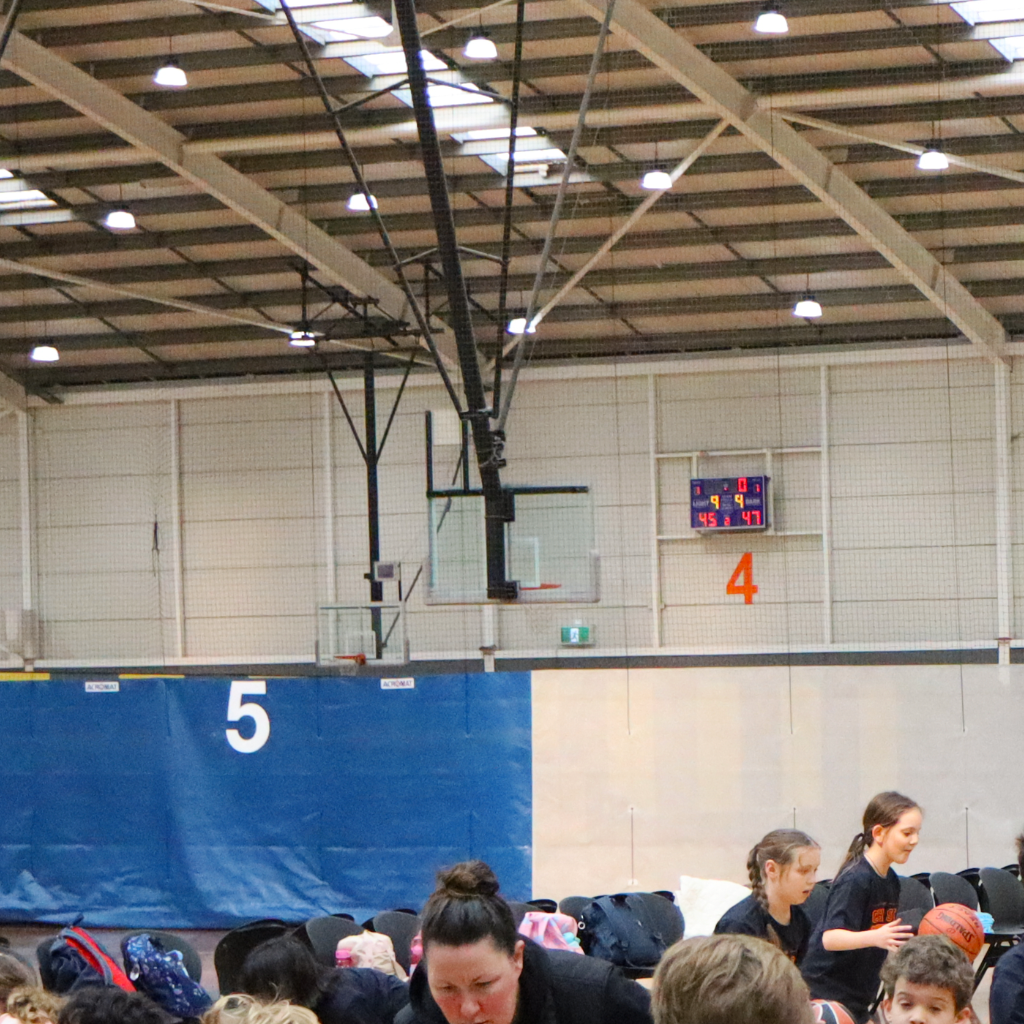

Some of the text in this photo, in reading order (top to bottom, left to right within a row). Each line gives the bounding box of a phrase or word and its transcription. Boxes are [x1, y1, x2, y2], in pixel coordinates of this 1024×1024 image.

[699, 512, 717, 526] 45
[742, 510, 761, 525] 47
[726, 551, 758, 605] 4
[225, 680, 270, 754] 5
